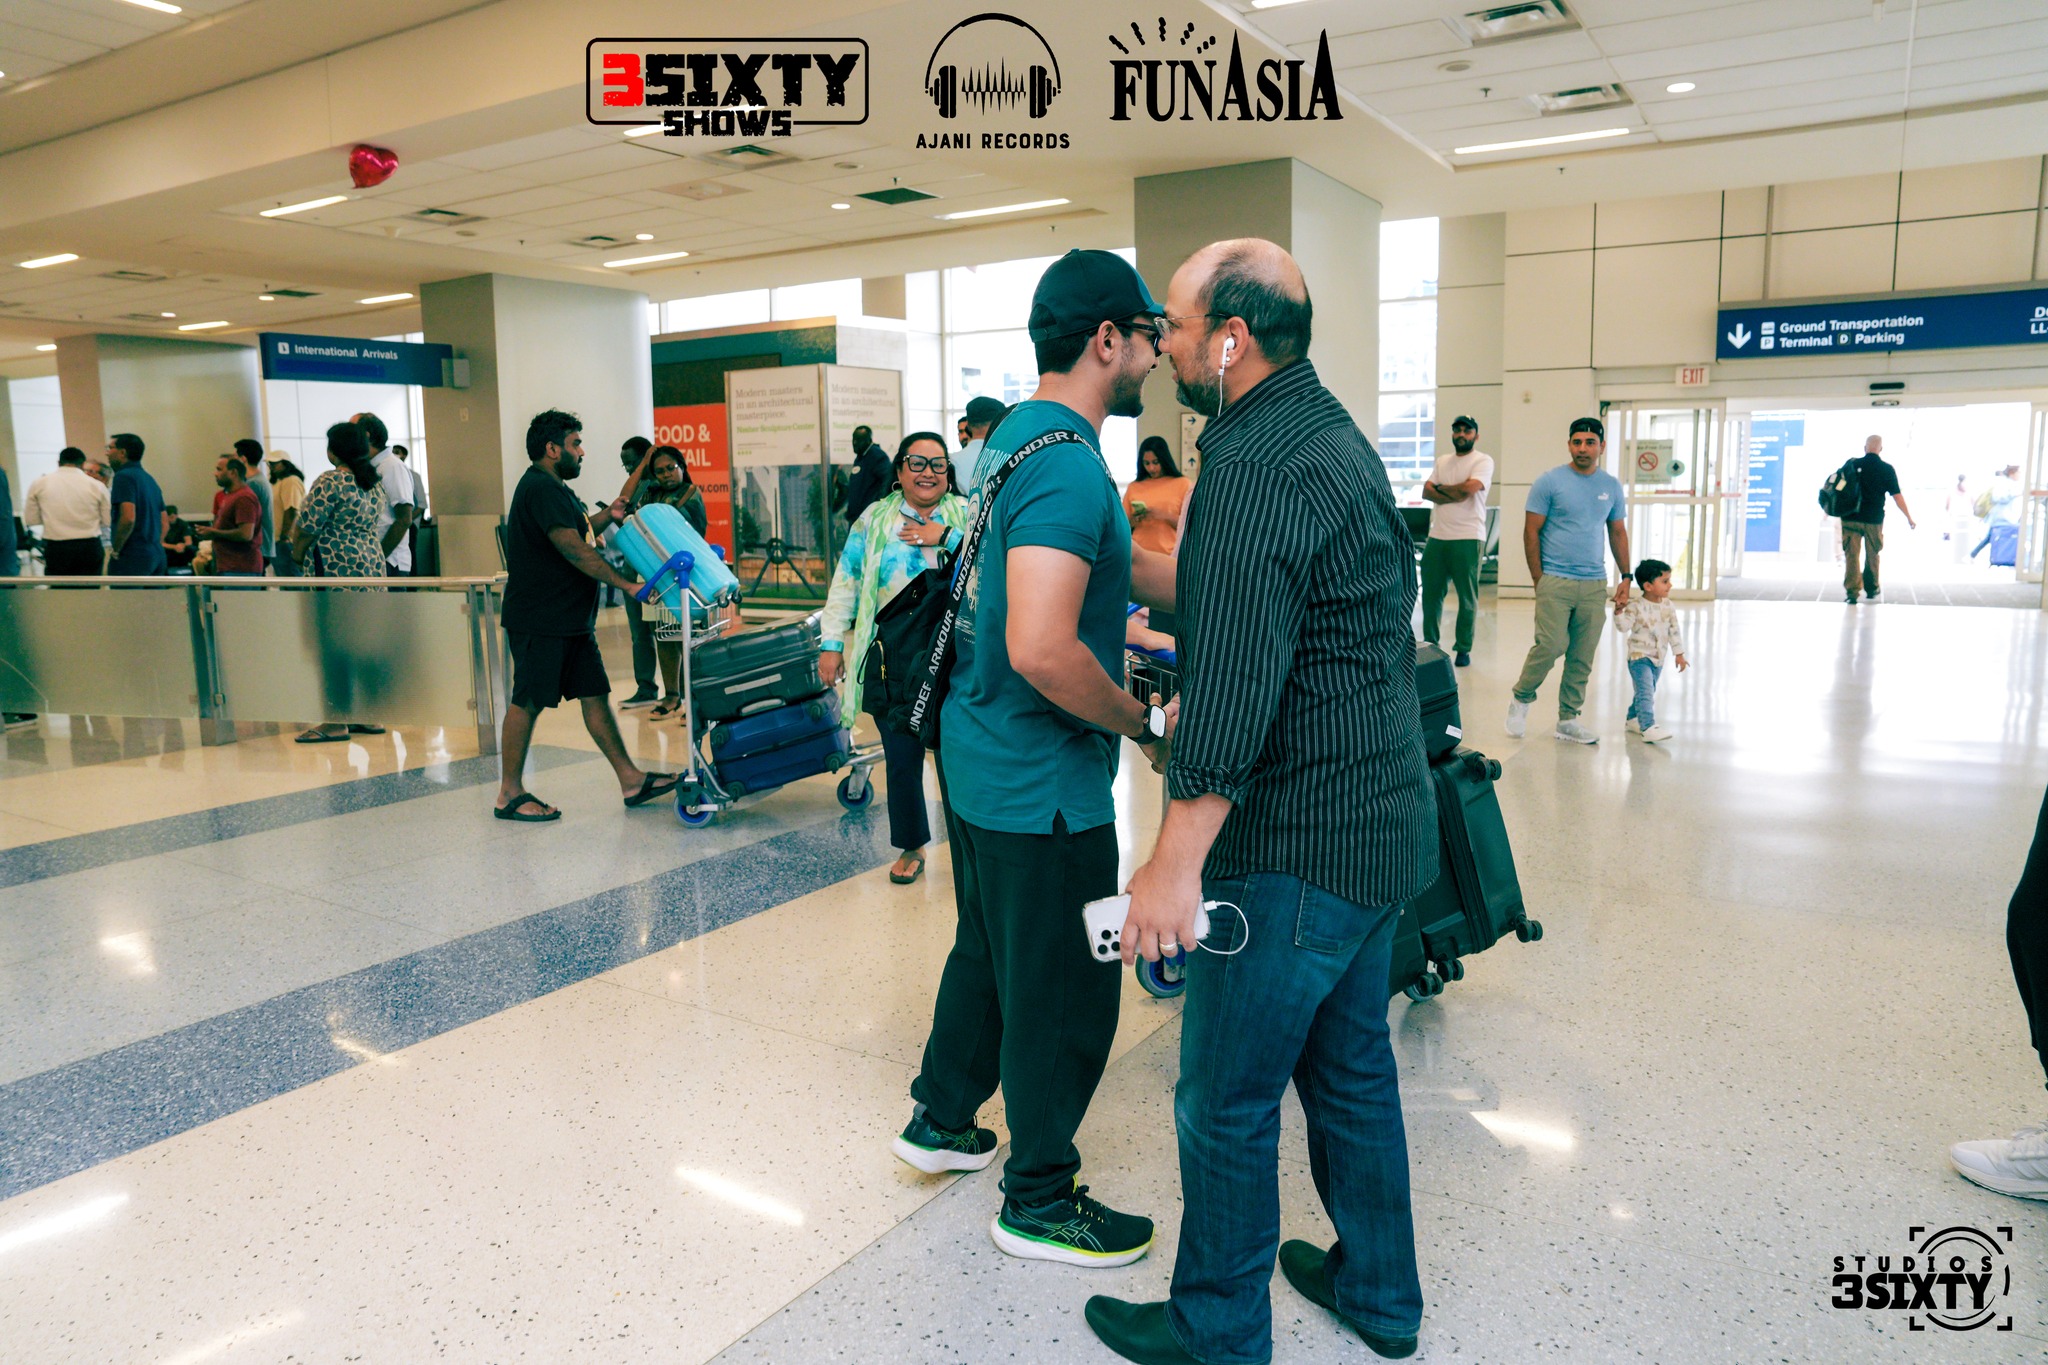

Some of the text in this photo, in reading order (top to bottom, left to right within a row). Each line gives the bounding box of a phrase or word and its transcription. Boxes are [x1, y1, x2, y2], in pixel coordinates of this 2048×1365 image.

[1779, 315, 1924, 334] Ground Transportation
[1779, 335, 1833, 348] Terminal
[1839, 333, 1849, 344] D
[1854, 332, 1905, 346] Parking
[294, 344, 399, 360] International Arrivals
[1682, 368, 1705, 385] EXIT
[697, 423, 712, 443] &
[928, 609, 955, 677] ARMOUR
[952, 544, 976, 602] UNDER
[1008, 431, 1070, 469] UNDER
